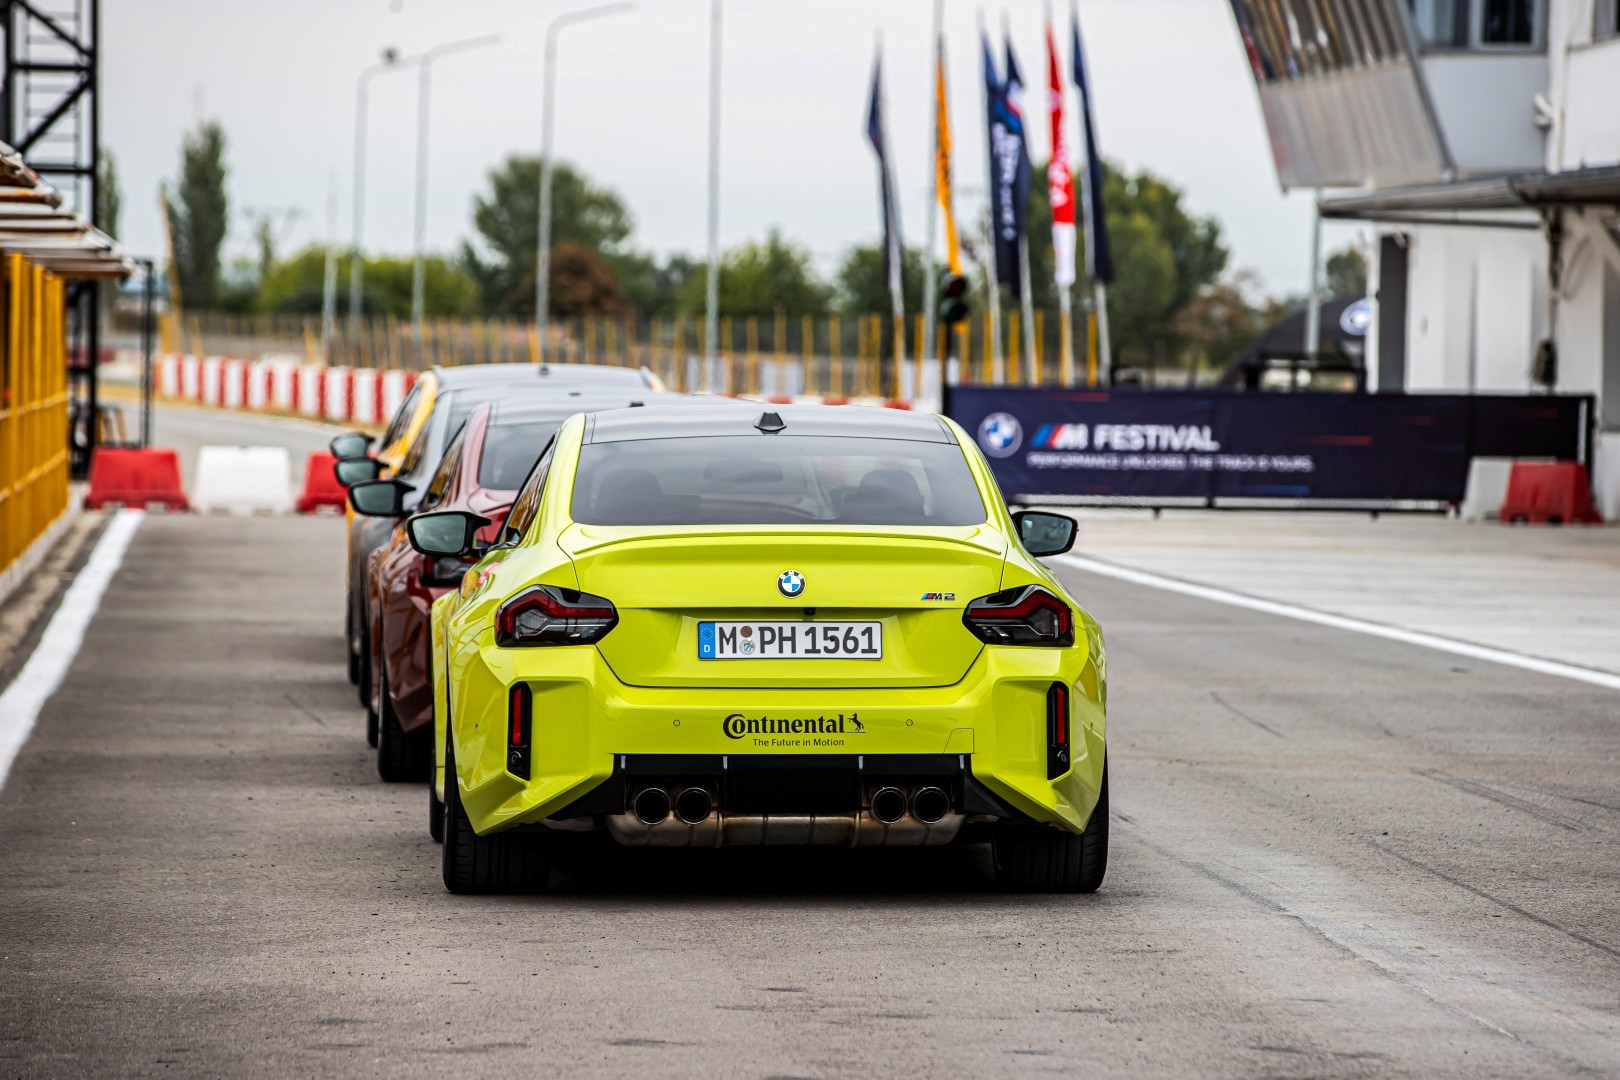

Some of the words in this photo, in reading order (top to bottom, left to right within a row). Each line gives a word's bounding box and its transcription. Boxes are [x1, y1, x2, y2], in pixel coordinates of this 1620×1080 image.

[1093, 423, 1220, 450] FESTIVAL
[703, 644, 711, 653] D
[718, 626, 737, 654] M
[758, 626, 797, 654] PH
[804, 626, 878, 654] 1561
[723, 713, 845, 739] Continental
[753, 738, 769, 746] The
[772, 738, 800, 746] Future
[802, 738, 811, 746] in
[813, 738, 844, 746] Motion
